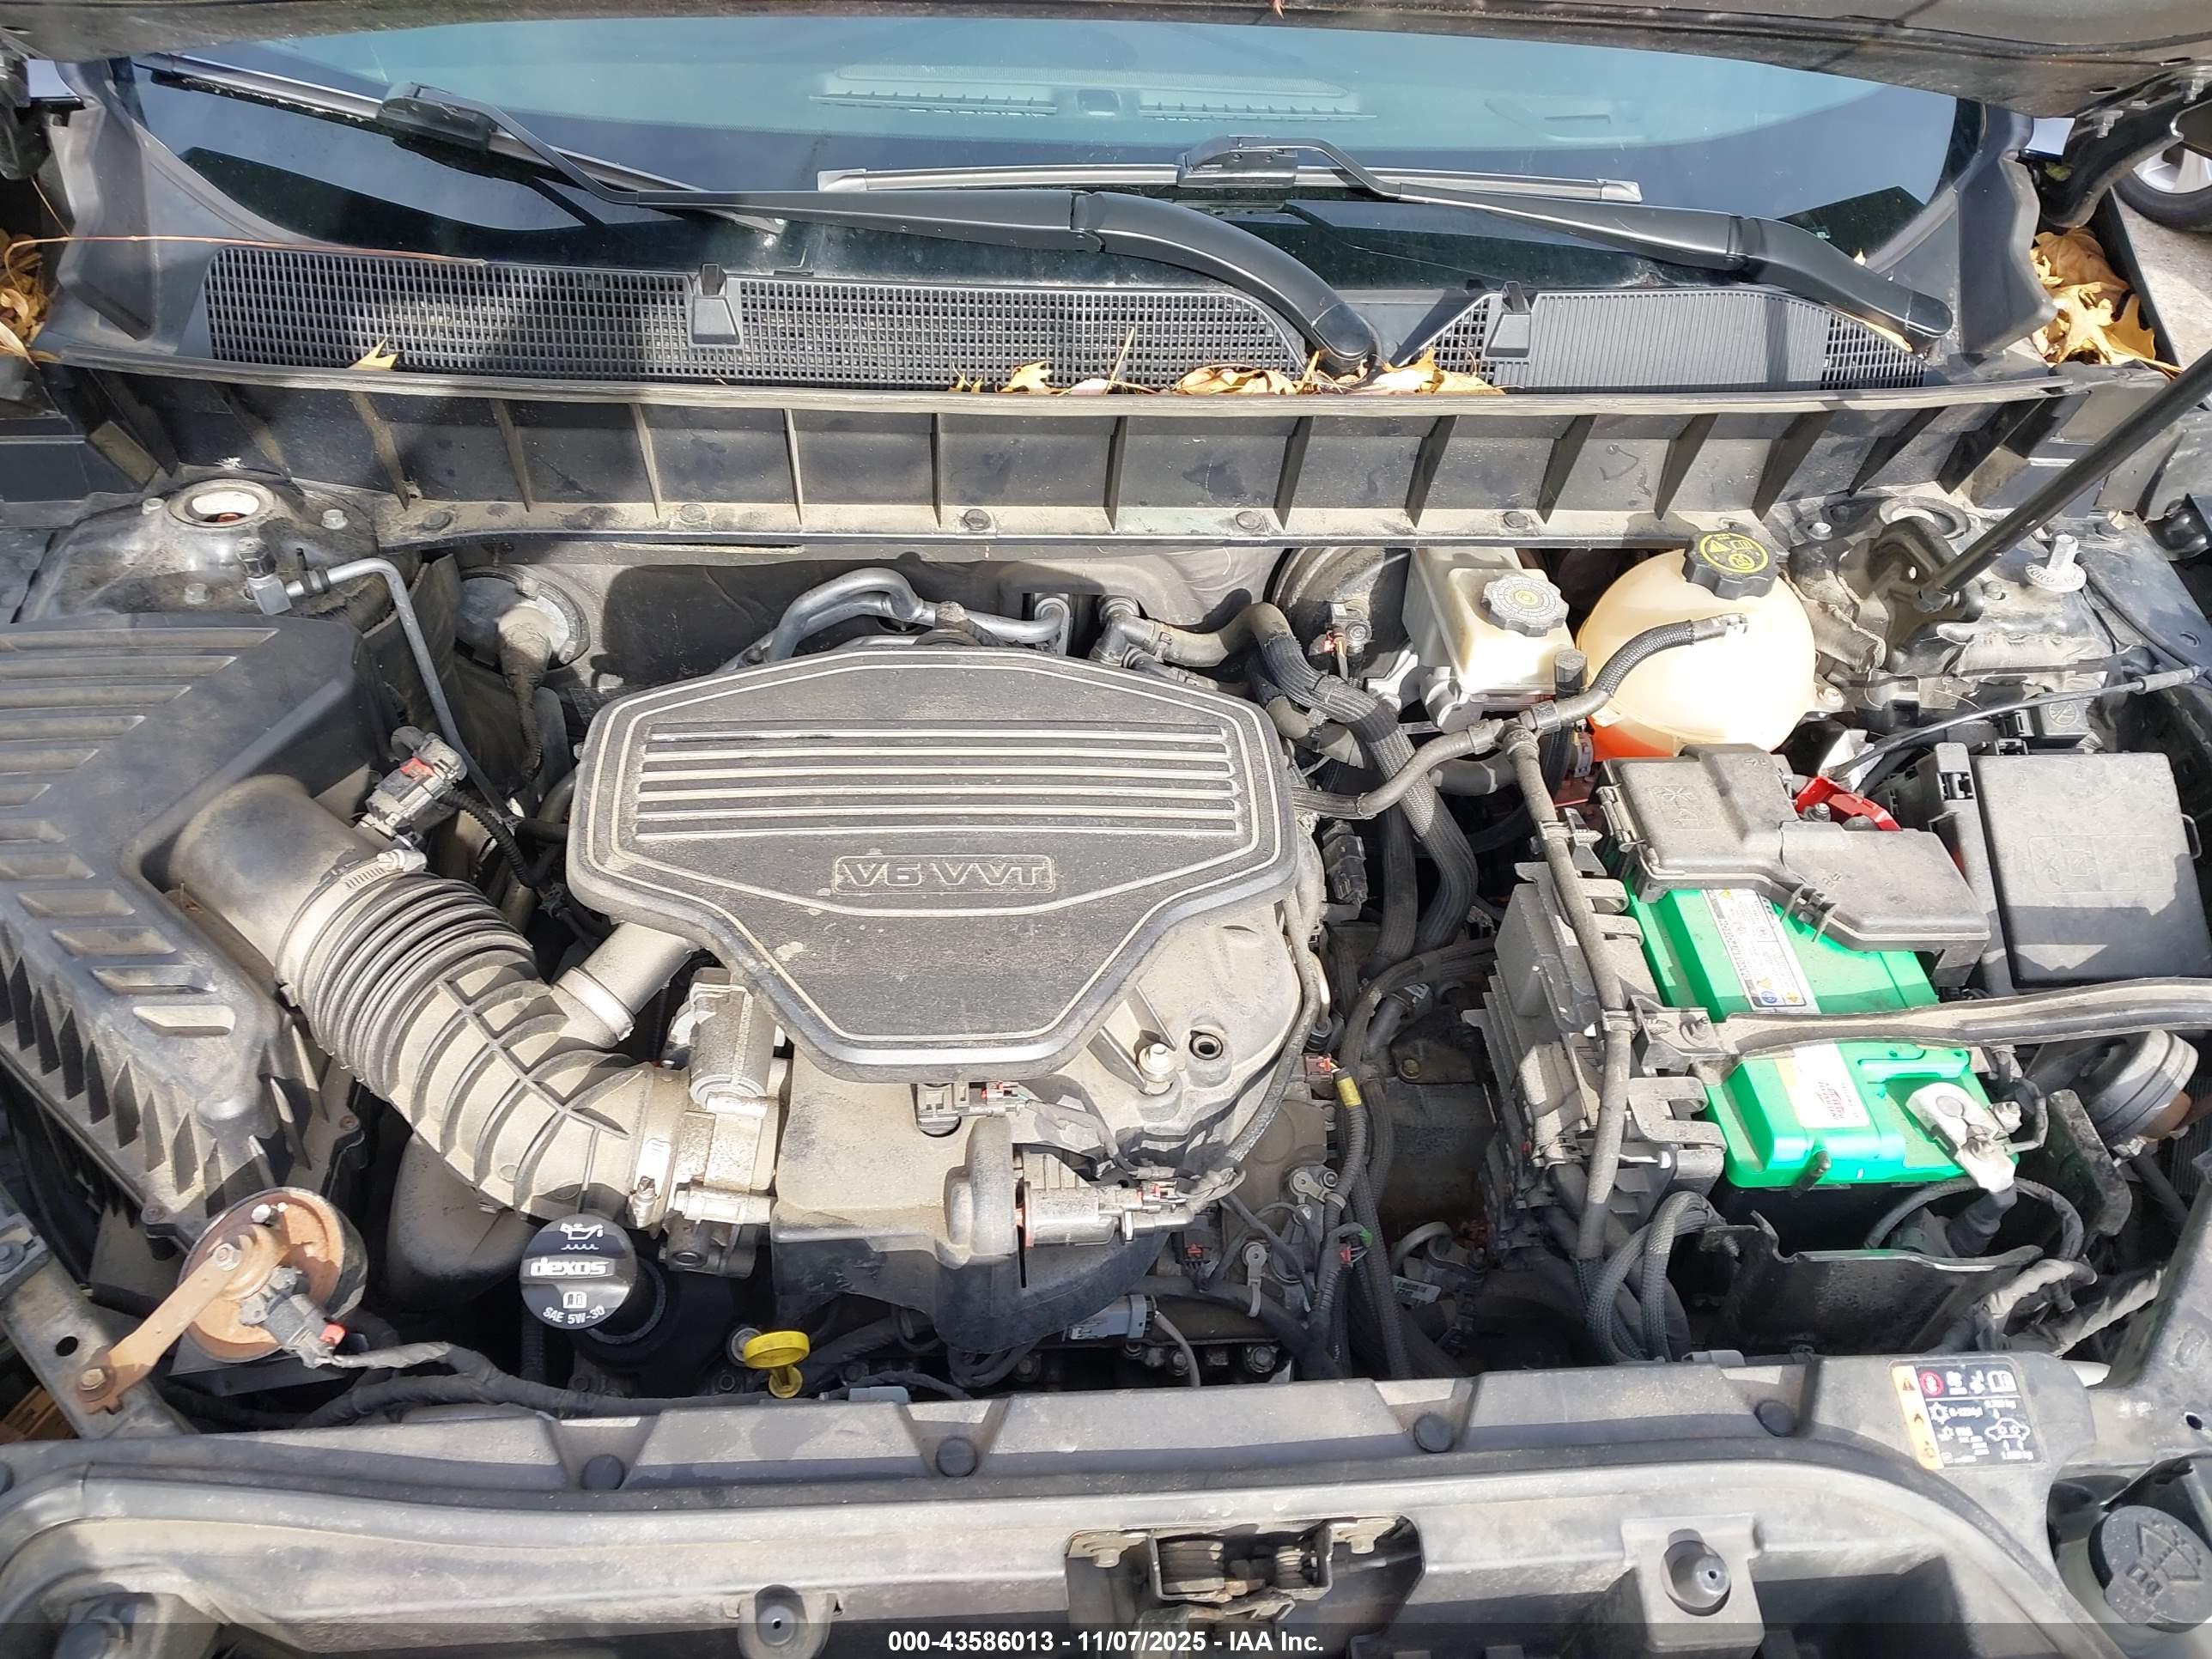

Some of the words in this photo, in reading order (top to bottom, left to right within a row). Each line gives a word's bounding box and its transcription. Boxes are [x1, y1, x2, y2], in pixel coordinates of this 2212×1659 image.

[842, 862, 921, 886] V6
[932, 862, 1045, 885] VVT
[530, 1256, 611, 1277] dexos
[543, 1306, 565, 1322] SAE
[567, 1304, 605, 1324] 5W-30
